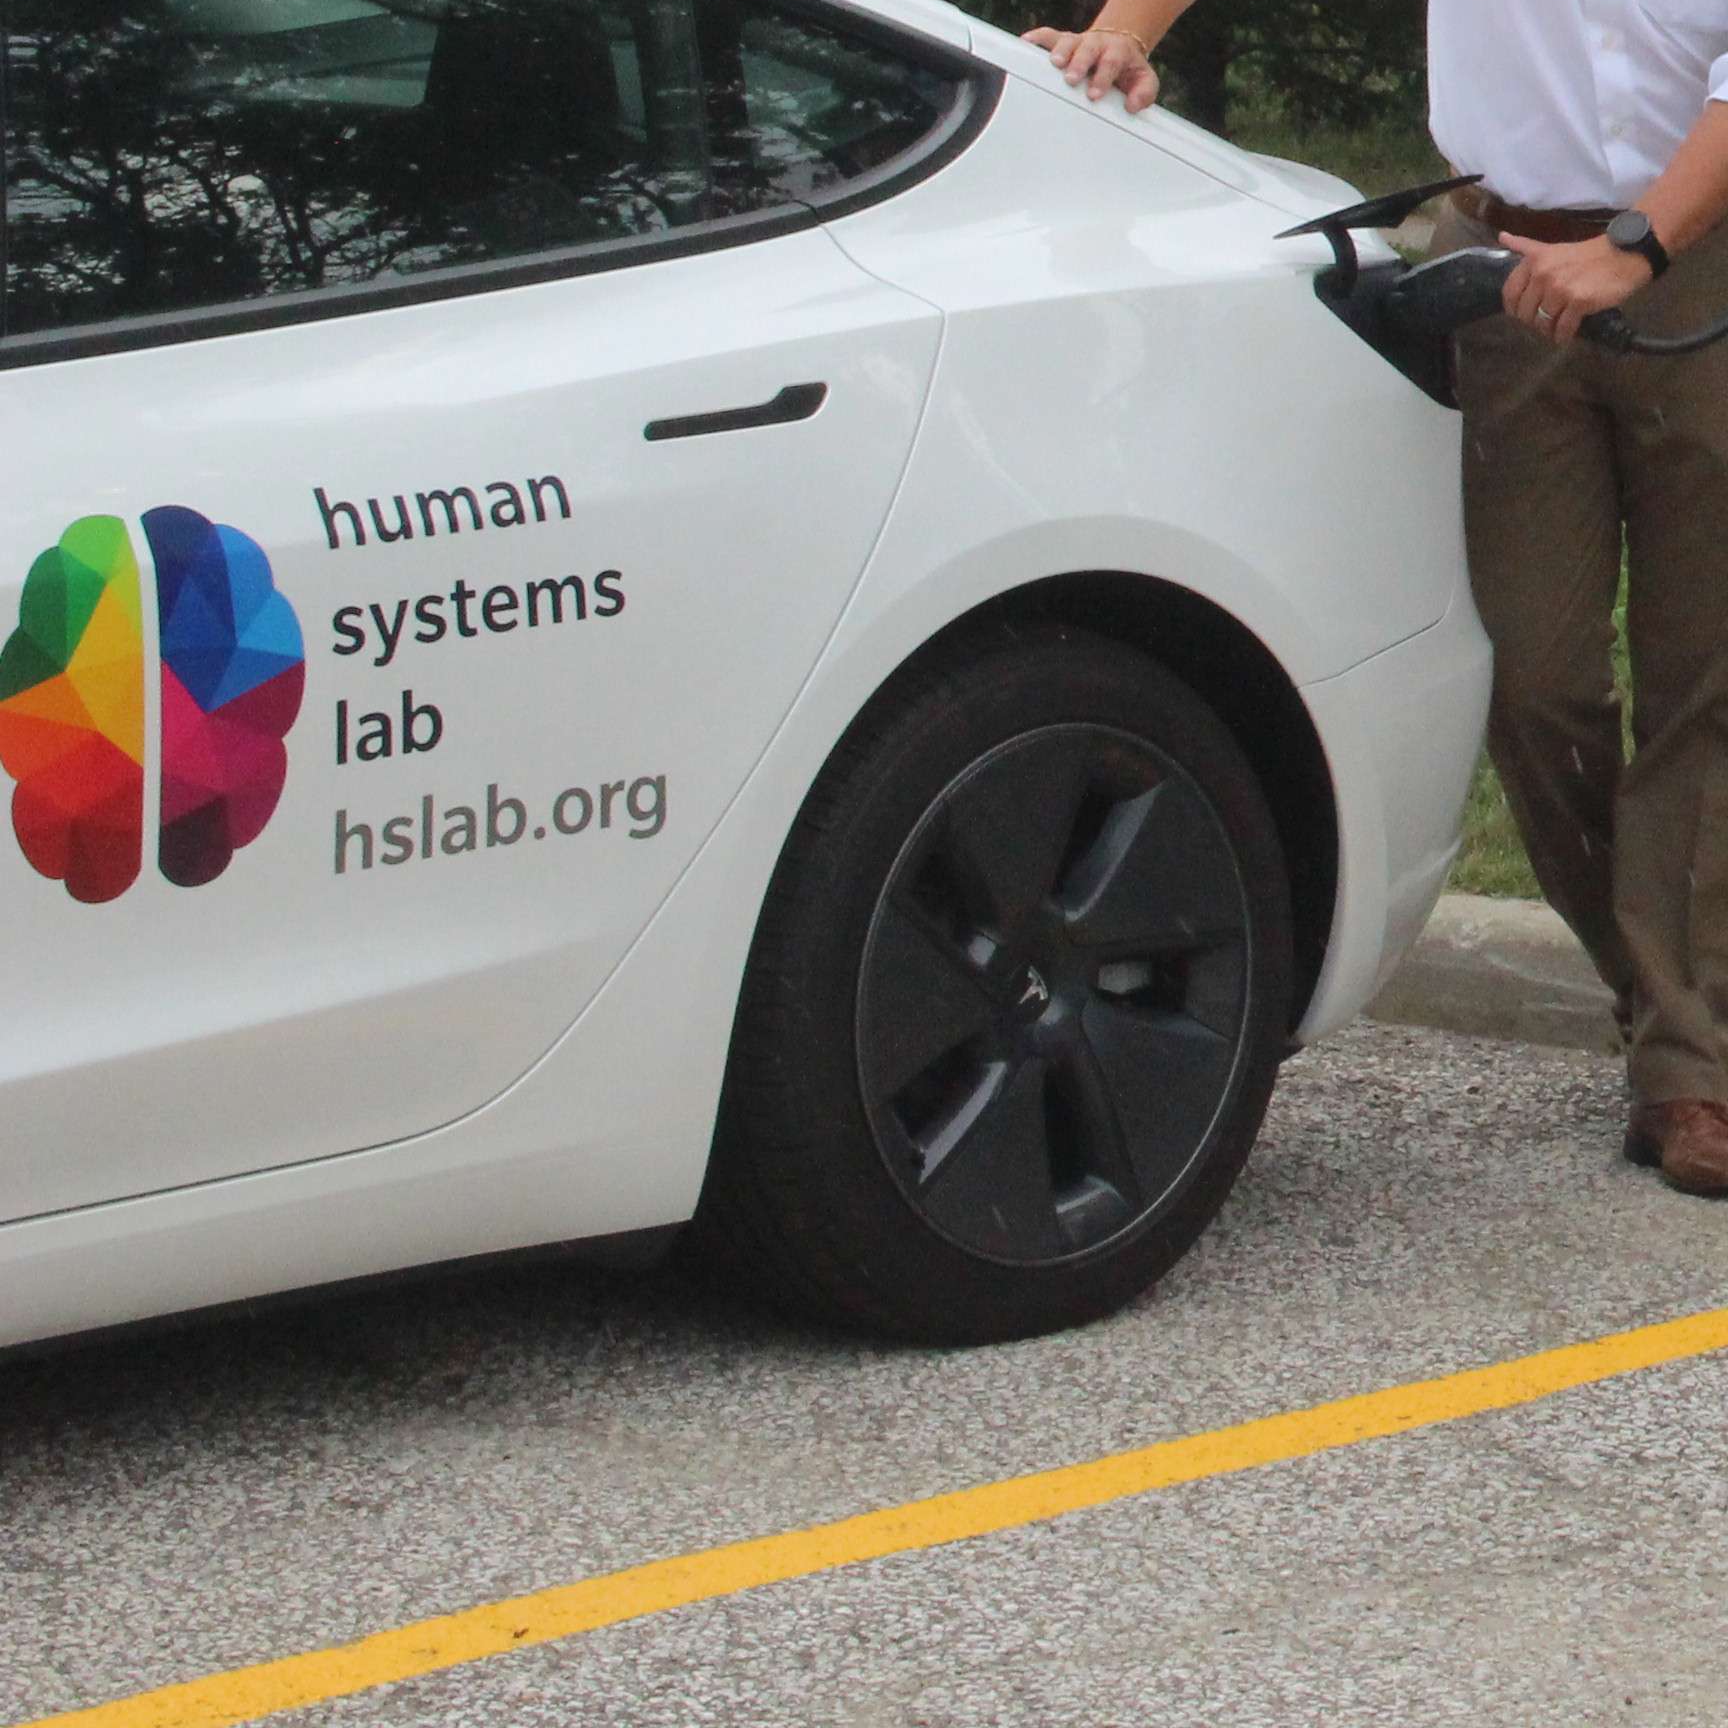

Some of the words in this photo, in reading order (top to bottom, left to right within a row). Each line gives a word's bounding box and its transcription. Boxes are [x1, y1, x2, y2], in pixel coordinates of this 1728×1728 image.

[313, 474, 572, 549] human
[330, 568, 626, 667] systems
[335, 689, 444, 765] lab
[333, 774, 668, 874] hslab.org
